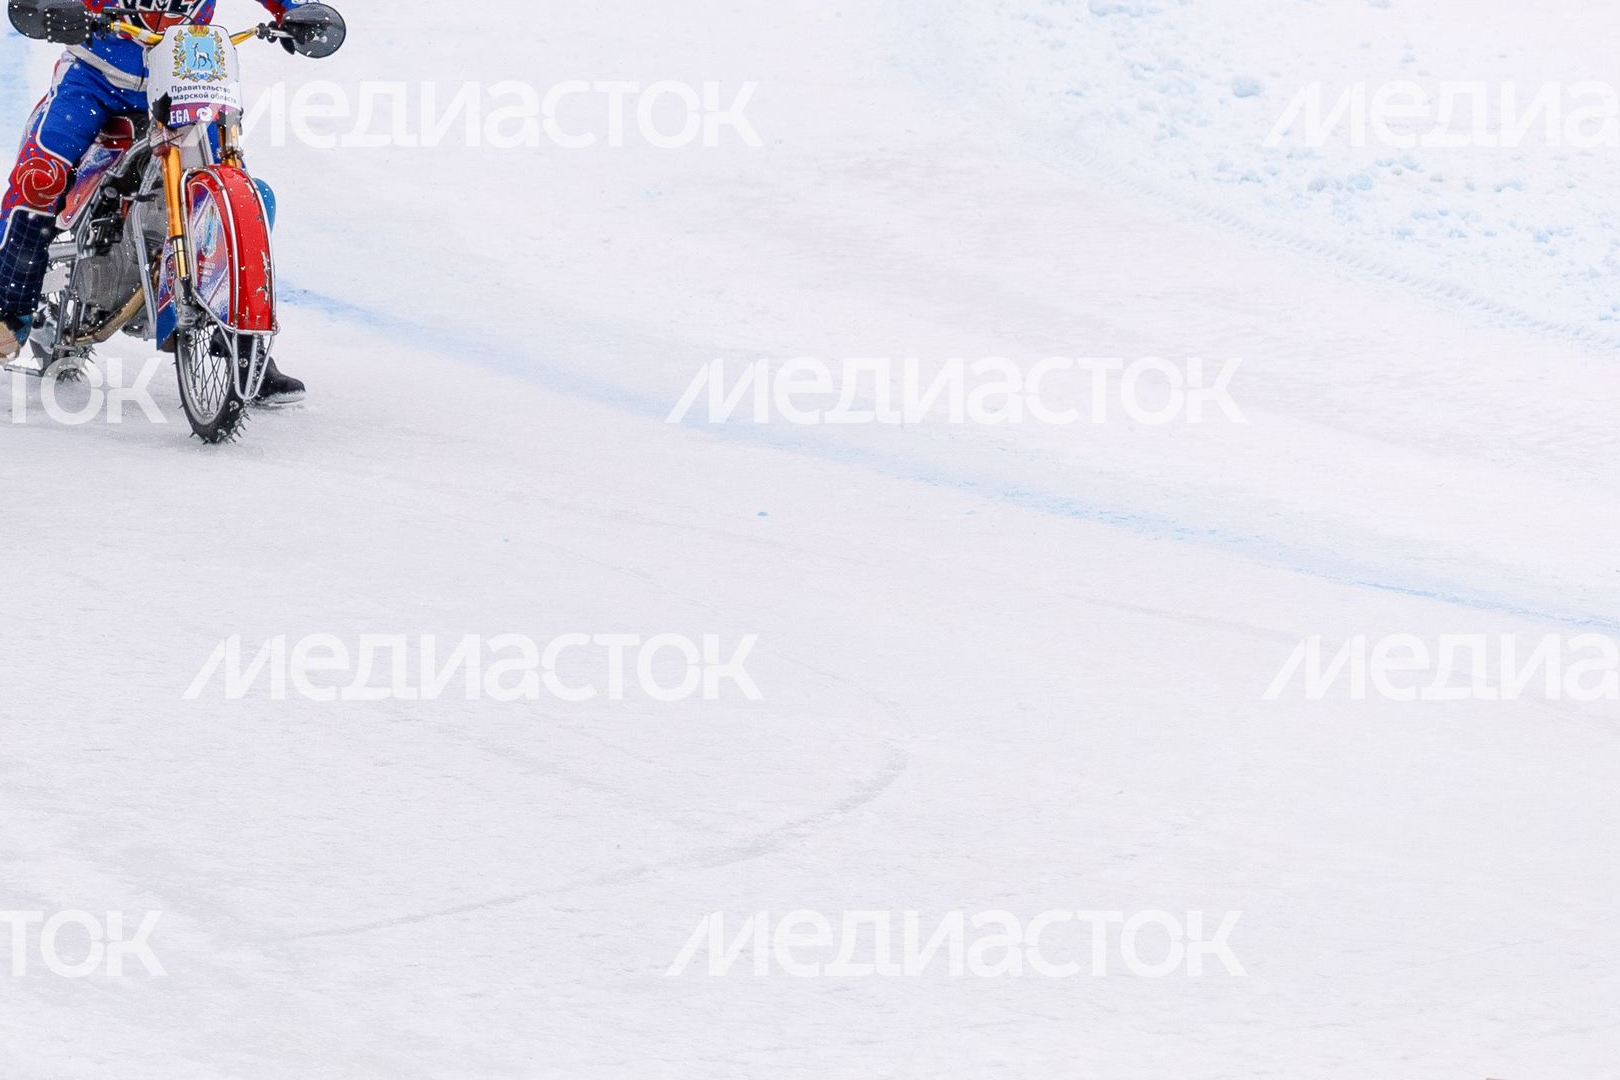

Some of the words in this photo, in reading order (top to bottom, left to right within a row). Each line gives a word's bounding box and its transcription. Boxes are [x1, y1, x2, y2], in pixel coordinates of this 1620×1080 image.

[170, 84, 232, 95] Правительство
[172, 91, 210, 102] марской
[169, 107, 192, 126] EGA
